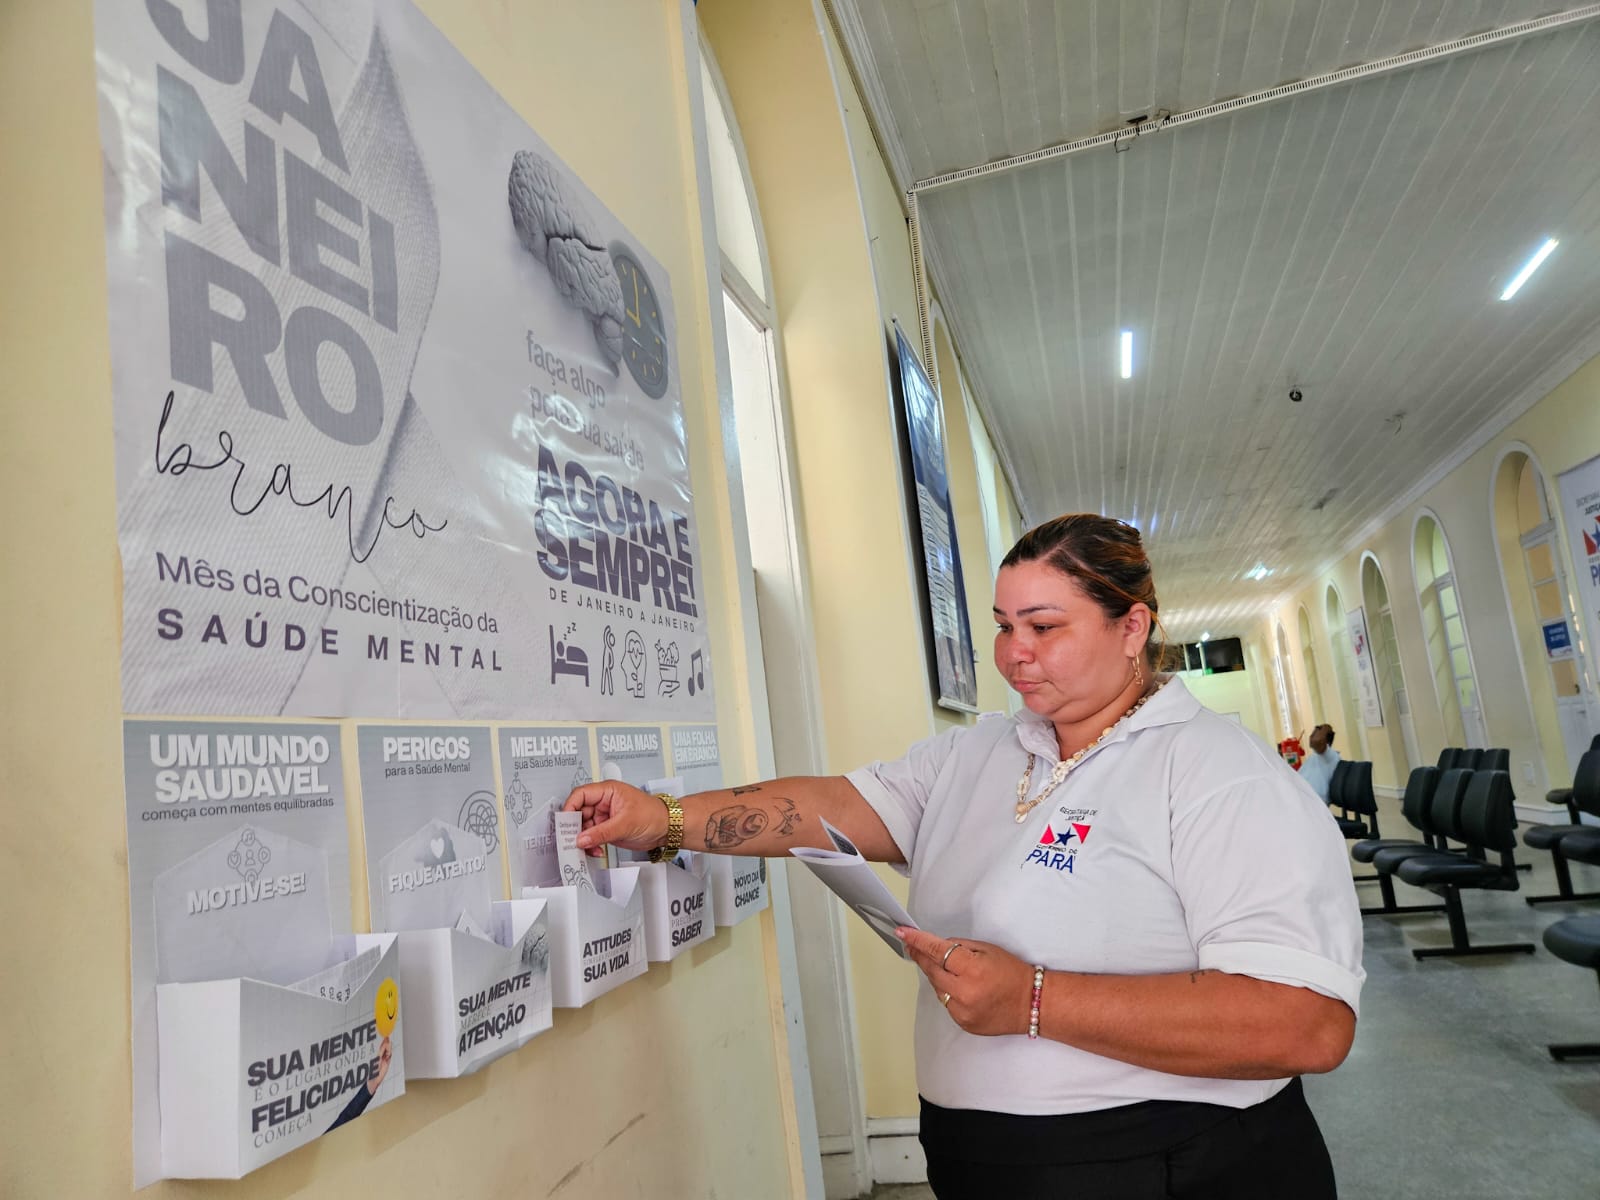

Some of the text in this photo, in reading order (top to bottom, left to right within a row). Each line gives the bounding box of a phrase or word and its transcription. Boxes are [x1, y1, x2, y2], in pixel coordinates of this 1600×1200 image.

[156, 63, 399, 334] NEI
[164, 227, 385, 447] RO
[526, 329, 606, 410] faça algo
[156, 390, 448, 564] branco
[535, 444, 693, 567] AGORA E
[534, 508, 699, 618] SEMPRE!
[156, 551, 499, 634] Mês da Conscientização da
[549, 587, 696, 633] DE JANEIRO A JANEIRO
[157, 607, 502, 672] SAÚDE MENTAL
[150, 734, 331, 767] UM MUNDO
[382, 736, 472, 763] PERIGOS
[510, 735, 579, 758] MELHORE
[602, 732, 659, 753] SAIBA MAIS
[672, 730, 717, 747] UMA FOLHA
[385, 766, 407, 779] para
[415, 763, 443, 775] Saúde
[444, 762, 471, 774] Mental
[514, 758, 529, 770] sua
[554, 755, 577, 767] Mental
[141, 797, 335, 822] começa com mentes equilibradas
[389, 854, 488, 894] FIQUE ATENTO!
[733, 873, 751, 889] NOVO
[670, 891, 704, 916] O QUE
[734, 886, 760, 908] CHANCE
[583, 927, 632, 959] ATITUDES
[671, 919, 703, 947] SABER
[583, 961, 607, 983] SUA
[609, 951, 630, 973] VIDA
[458, 970, 532, 1018] SUA MENTE
[458, 1002, 526, 1057] ATENÇÃO
[247, 1018, 377, 1087] SUA MENTE
[268, 1081, 280, 1097] O
[285, 1062, 332, 1092] LUGAR
[335, 1049, 367, 1074] ONDE
[251, 1055, 382, 1134] FELICIDADE
[253, 1112, 313, 1149] COMEÇA
